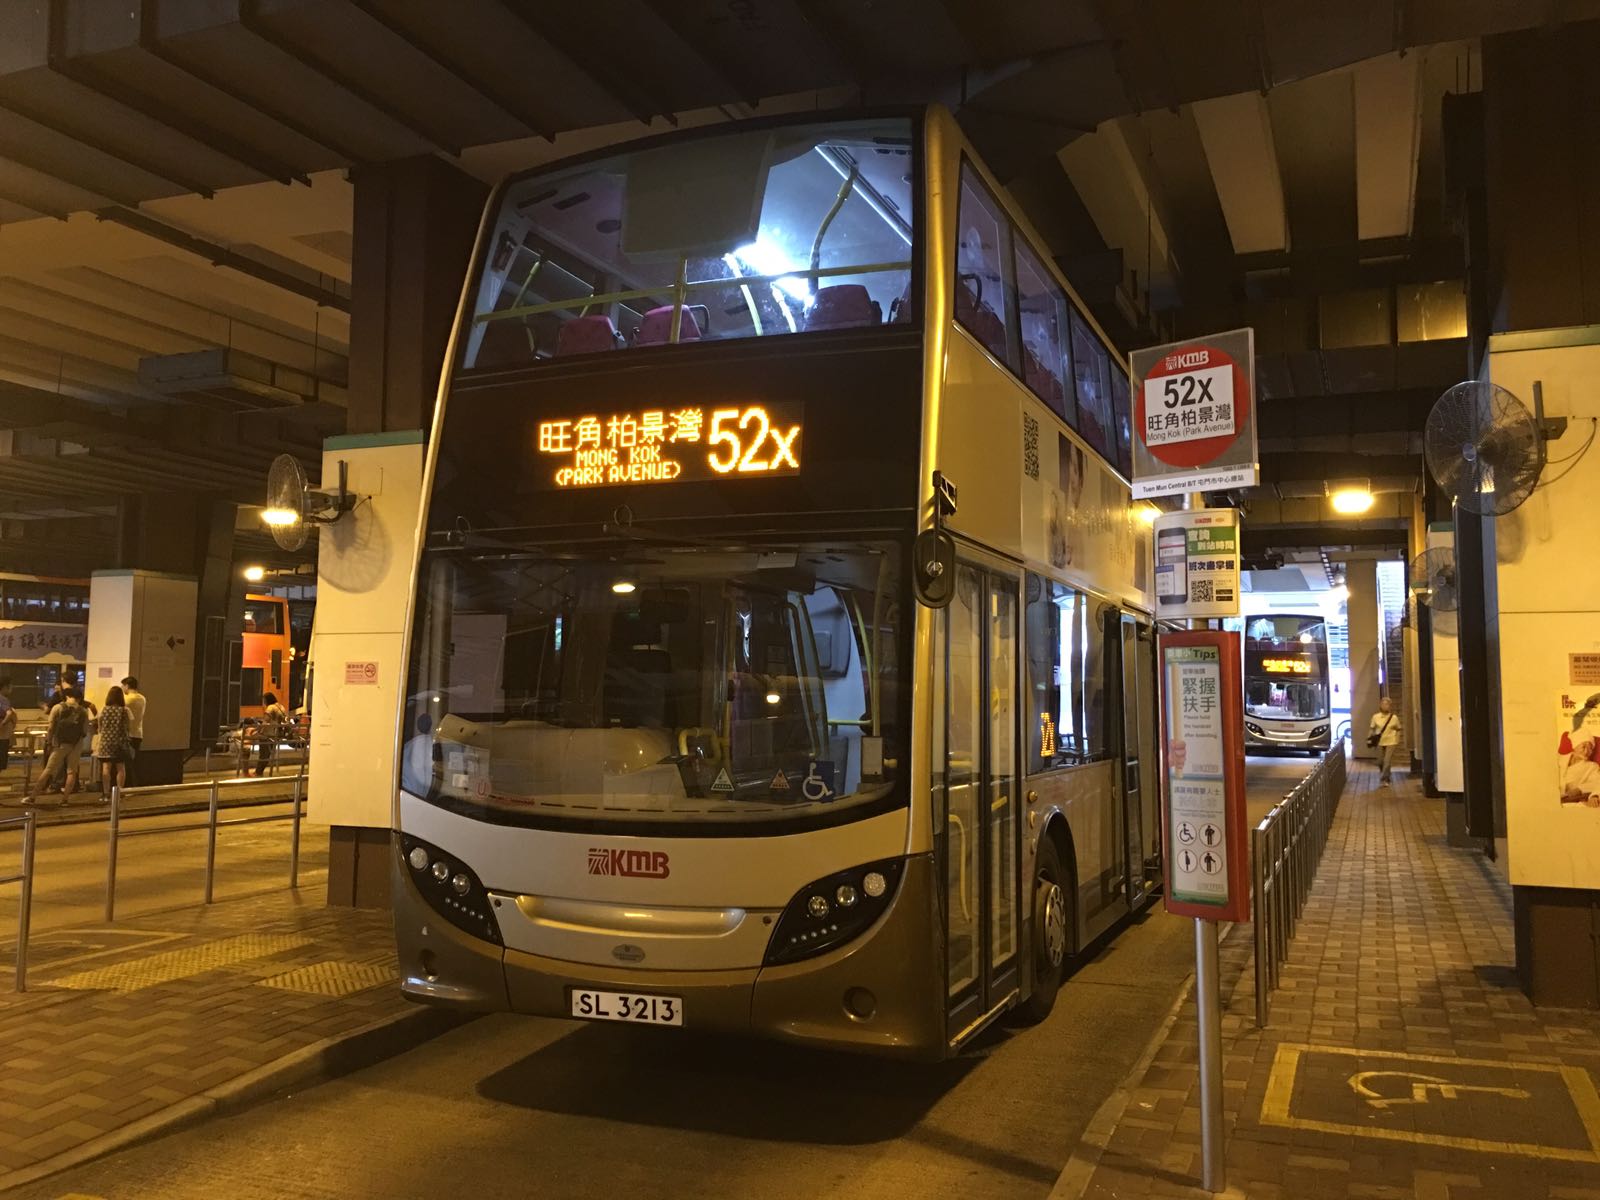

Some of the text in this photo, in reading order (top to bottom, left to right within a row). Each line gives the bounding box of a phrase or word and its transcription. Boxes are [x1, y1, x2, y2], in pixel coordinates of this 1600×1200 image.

[1164, 376, 1214, 409] 52X
[1148, 403, 1231, 431] 旺角柏景灣
[539, 408, 702, 453] 旺角柏景灣
[1147, 421, 1234, 442] Mong Kok (Park Avenue)
[575, 446, 661, 467] MONG KOK
[555, 461, 681, 486] (PARK AVENUE)
[1168, 481, 1187, 490] Central
[1193, 649, 1216, 660] Tips
[1182, 677, 1216, 695] 緊握
[1183, 696, 1217, 713] 扶手
[610, 849, 670, 880] KMB
[579, 993, 674, 1022] SL 3213
